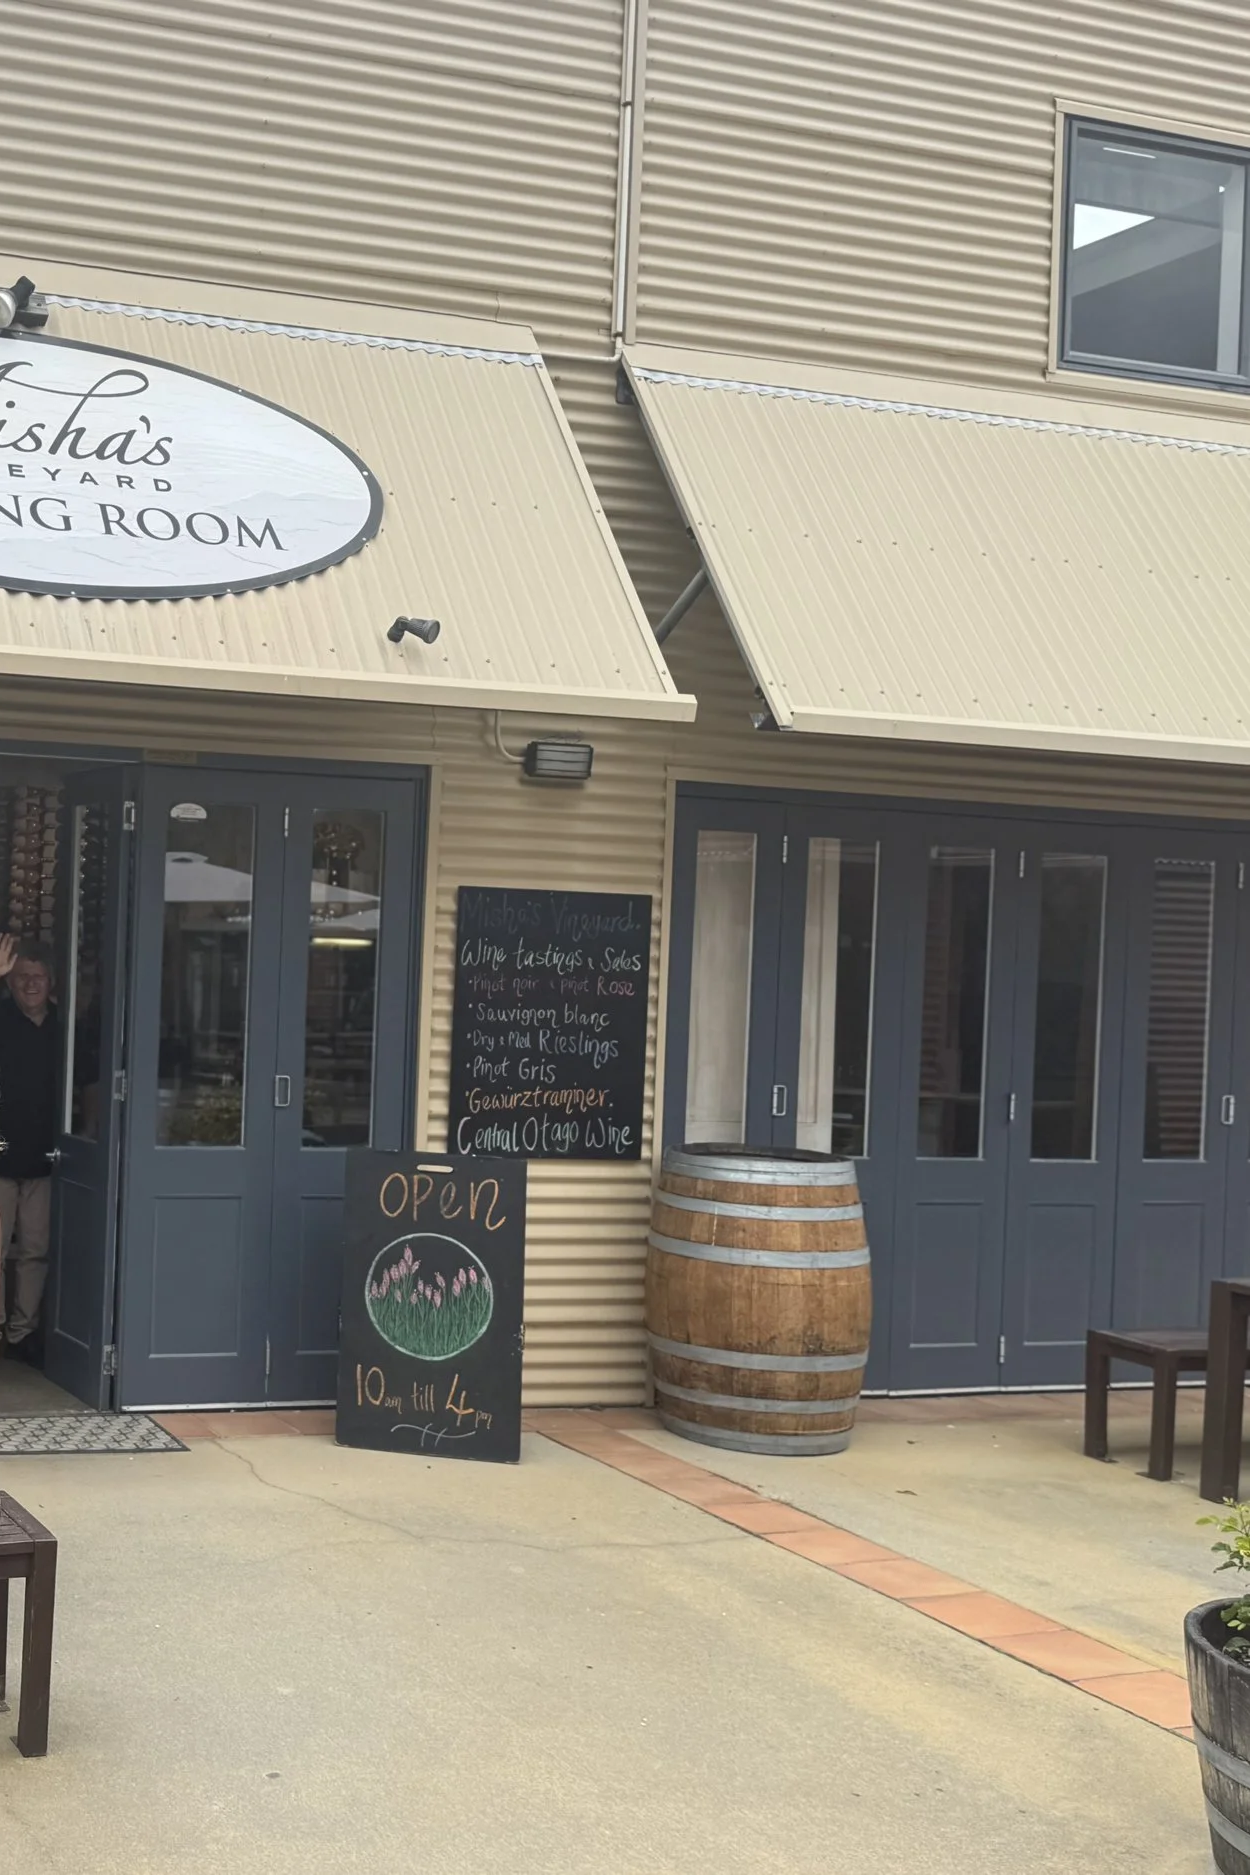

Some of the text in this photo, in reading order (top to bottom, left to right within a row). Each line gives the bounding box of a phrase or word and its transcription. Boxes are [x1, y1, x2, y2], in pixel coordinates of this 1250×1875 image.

[100, 503, 287, 550] ROOM
[461, 937, 507, 970] Wine
[512, 935, 583, 975] tastings
[600, 947, 642, 972] Sales
[513, 975, 540, 997] noir
[477, 1003, 611, 1032] Sauvignon blanc
[472, 1029, 495, 1052] Dry
[508, 1031, 532, 1049] Med
[539, 1029, 619, 1069] Rieslings
[473, 1055, 557, 1084] Pinot Gris
[457, 1113, 634, 1155] Central Otago Wine
[411, 1381, 435, 1413] till
